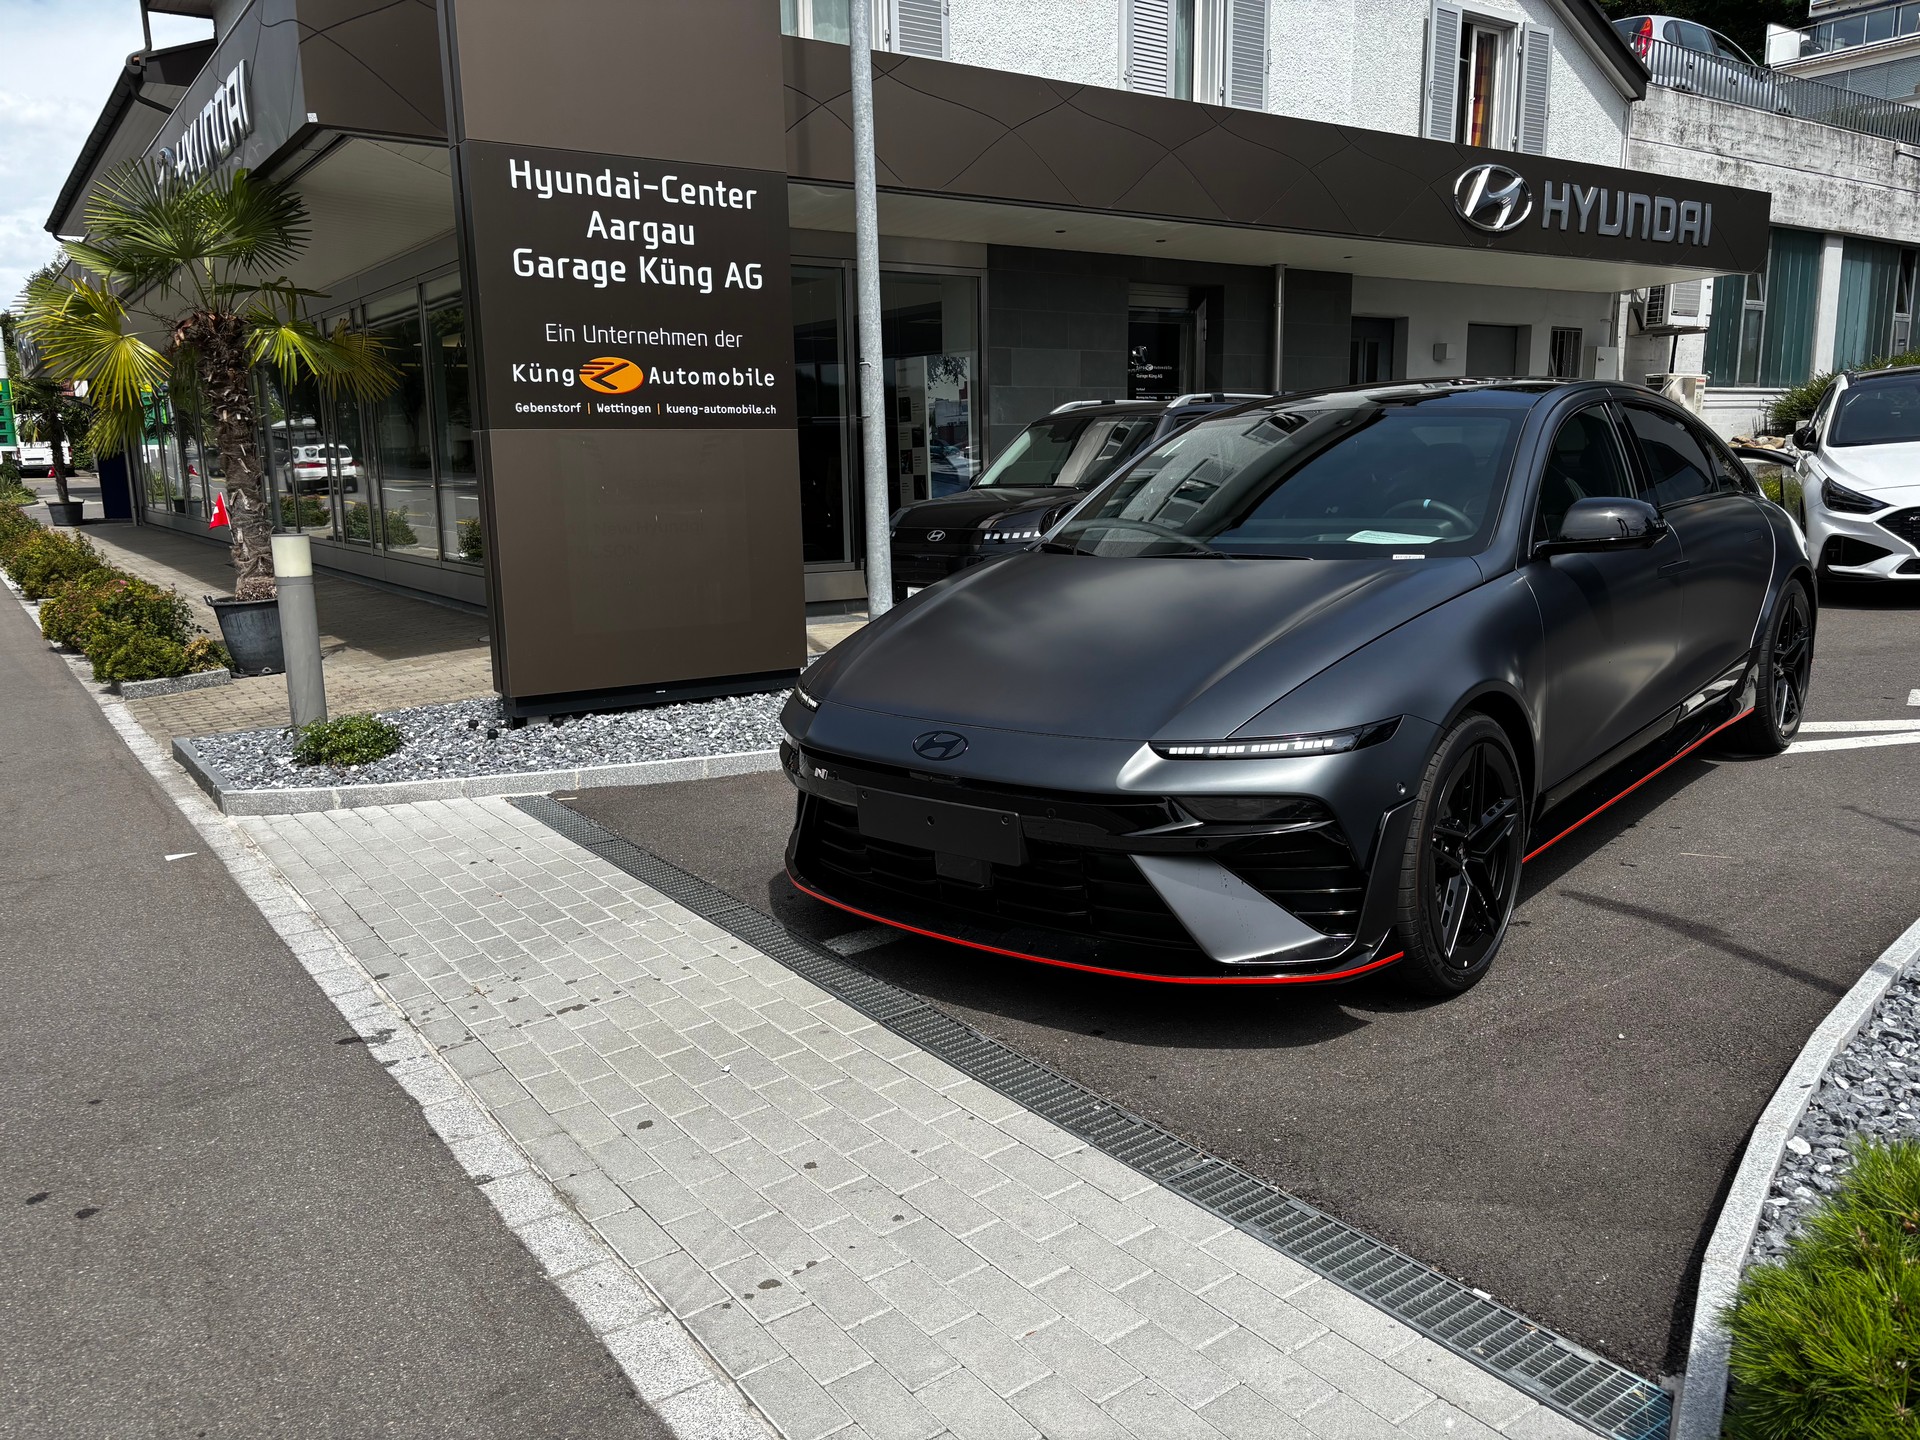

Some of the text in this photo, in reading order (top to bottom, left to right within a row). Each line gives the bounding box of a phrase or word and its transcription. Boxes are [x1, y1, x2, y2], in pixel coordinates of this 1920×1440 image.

[509, 158, 758, 210] Hyundai-Center
[586, 210, 695, 250] Aargau
[1541, 180, 1712, 247] HYUNDAI
[512, 247, 763, 294] Garage Küng AG
[545, 323, 743, 348] Ein Unternehmen der
[512, 362, 775, 387] Küng Automobile
[515, 402, 777, 416] Gebenstorf Wettingen kueng-automobile.ch
